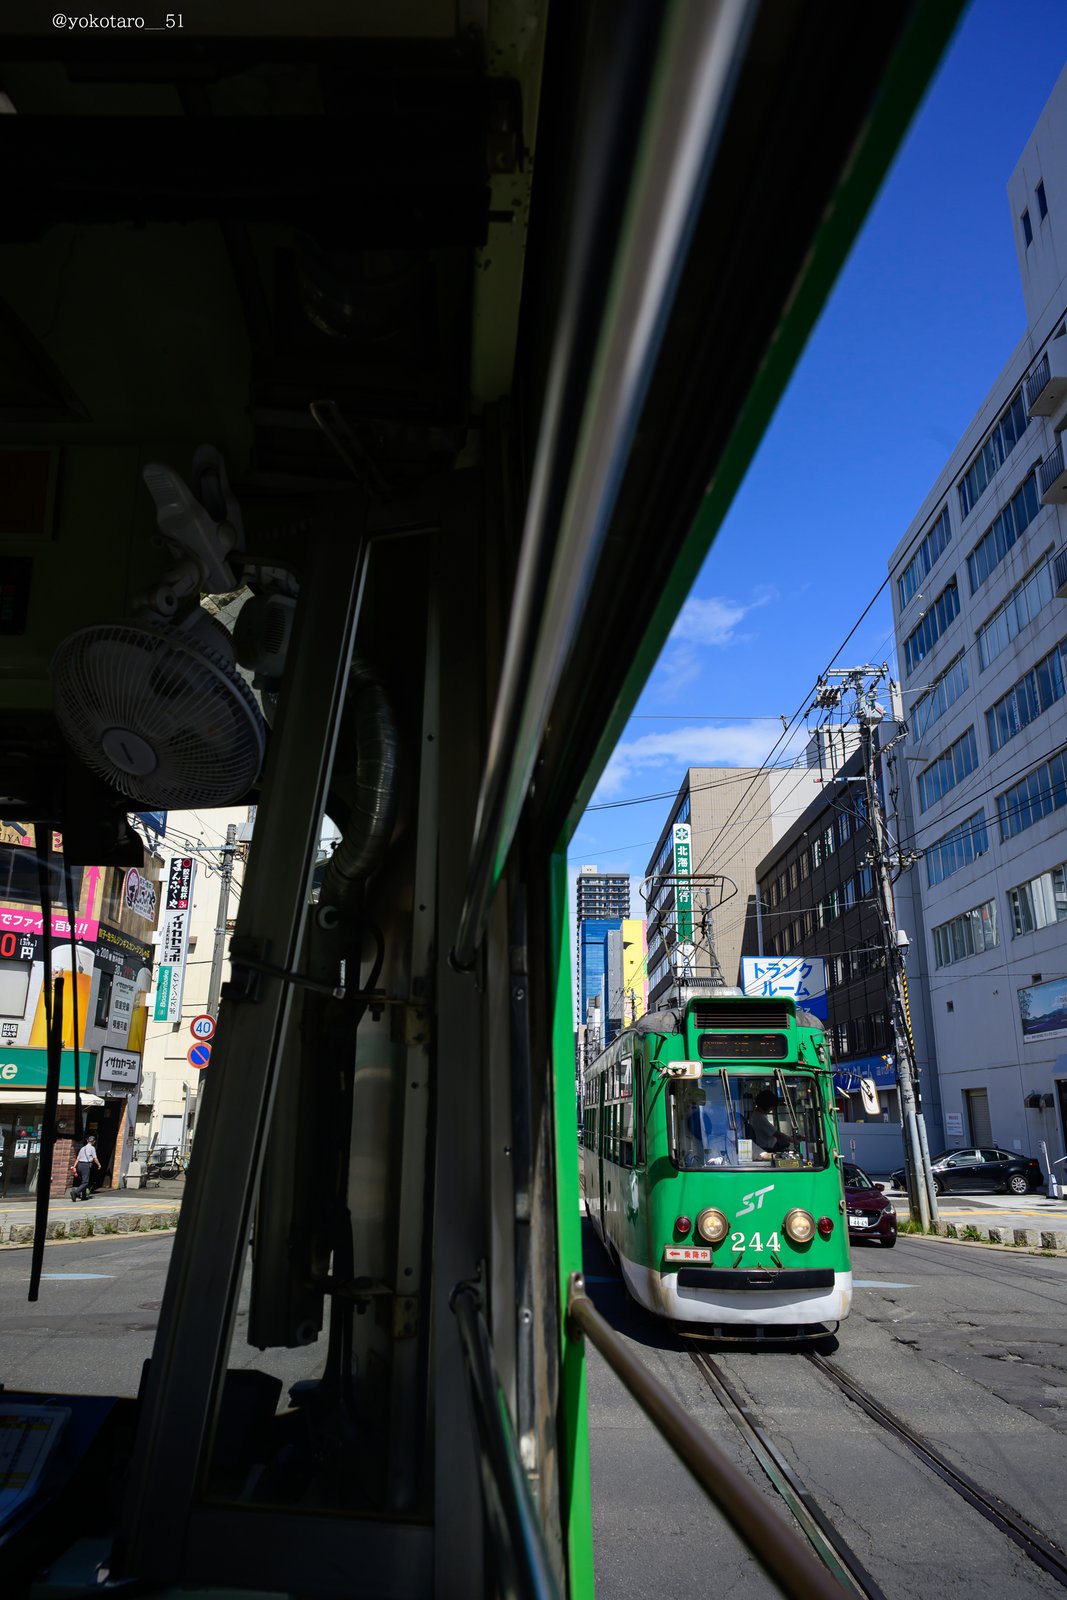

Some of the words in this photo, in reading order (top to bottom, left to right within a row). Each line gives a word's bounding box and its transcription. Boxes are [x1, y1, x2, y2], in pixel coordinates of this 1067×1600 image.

[169, 859, 182, 908] まんぷくや
[169, 913, 184, 962] イザカヤラボ
[754, 962, 813, 979] トランク
[761, 981, 810, 997] ルーム
[196, 1021, 211, 1033] 40
[105, 1056, 136, 1071] イザカヤラボ
[735, 1184, 775, 1217] ST
[731, 1231, 781, 1252] 244
[684, 1251, 708, 1259] 乗降中
